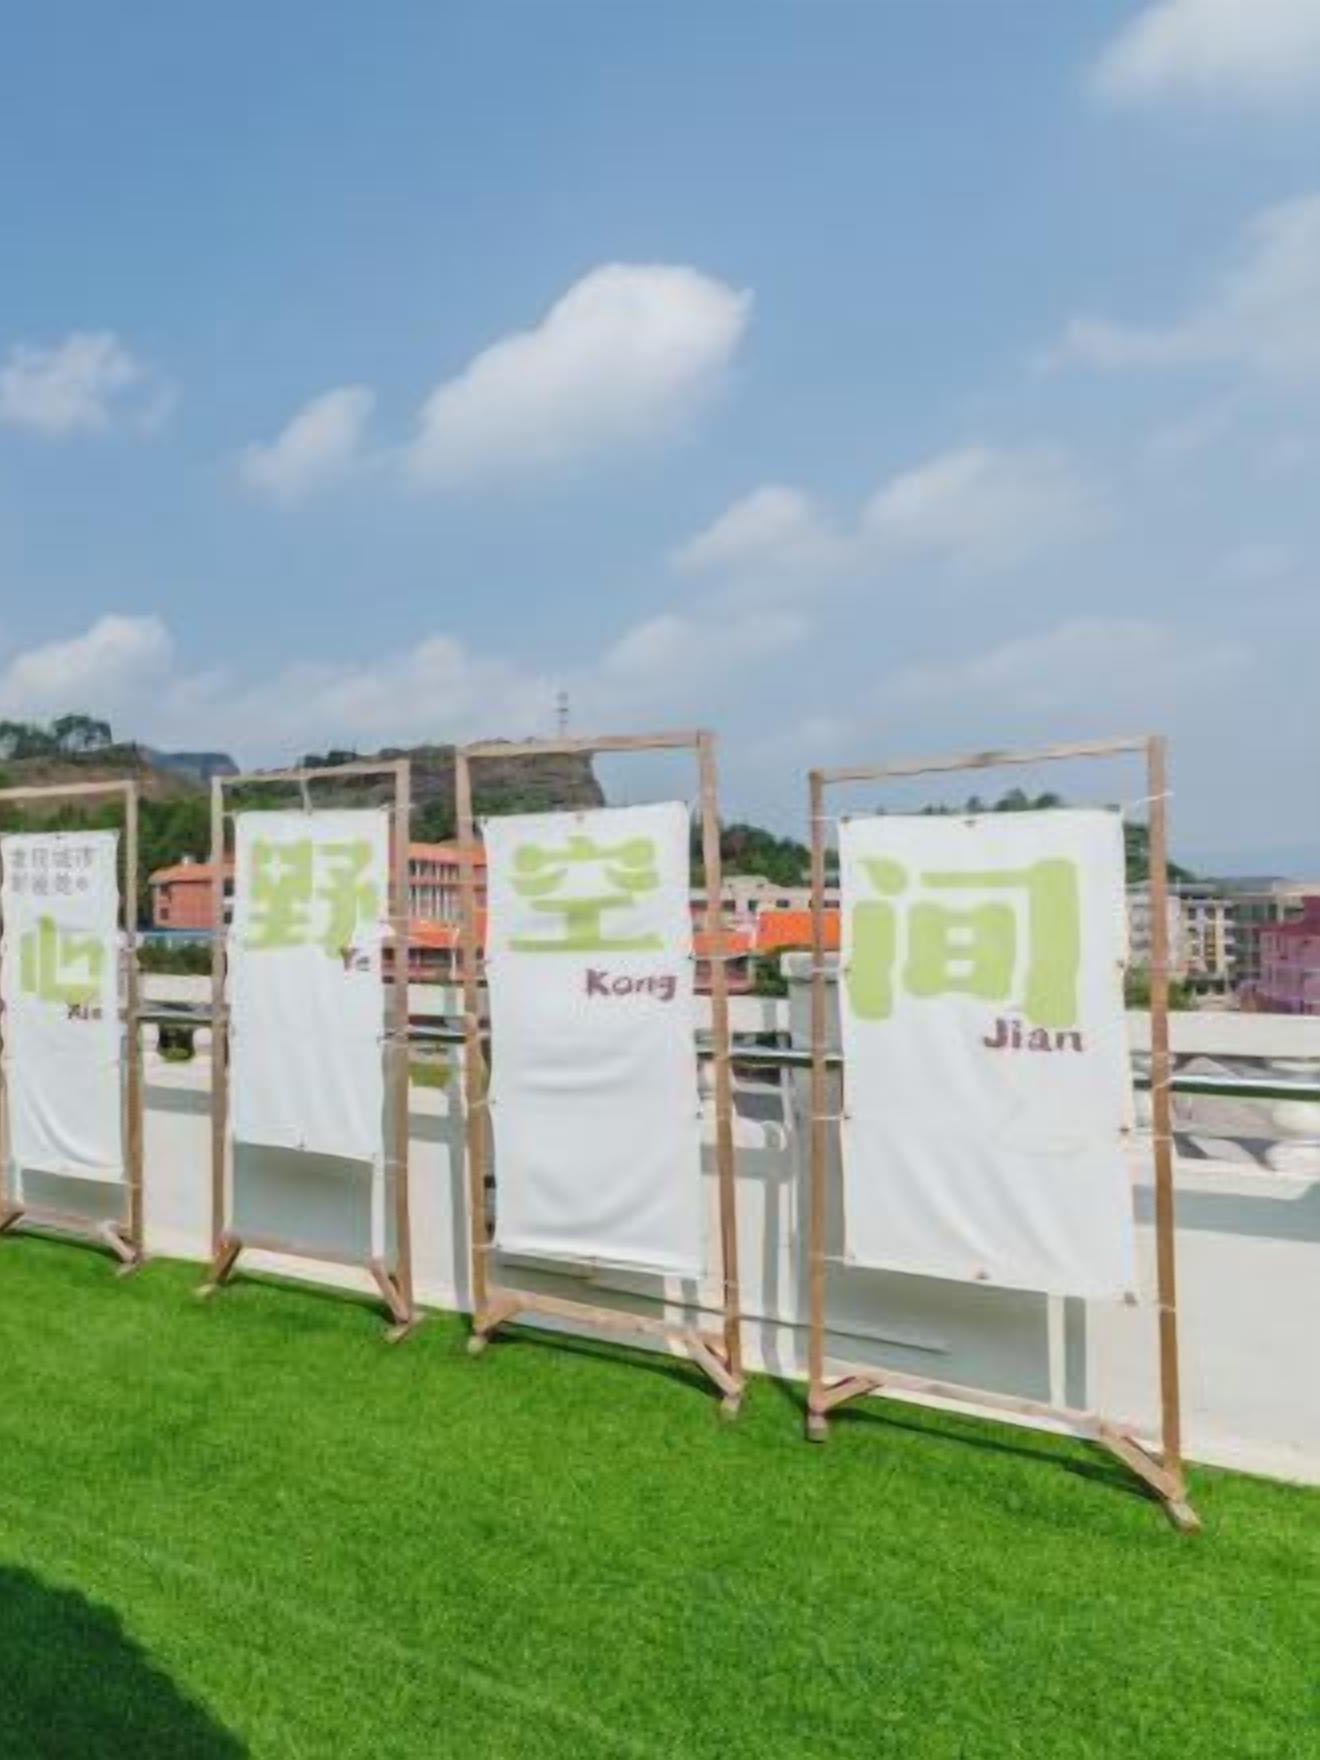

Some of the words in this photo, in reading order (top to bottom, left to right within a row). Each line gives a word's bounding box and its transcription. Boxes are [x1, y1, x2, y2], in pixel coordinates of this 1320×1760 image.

[247, 836, 377, 959] 野
[509, 834, 665, 953] 空
[847, 856, 1081, 1028] 间
[586, 967, 678, 1002] Kong
[983, 1017, 1084, 1053] Jian
